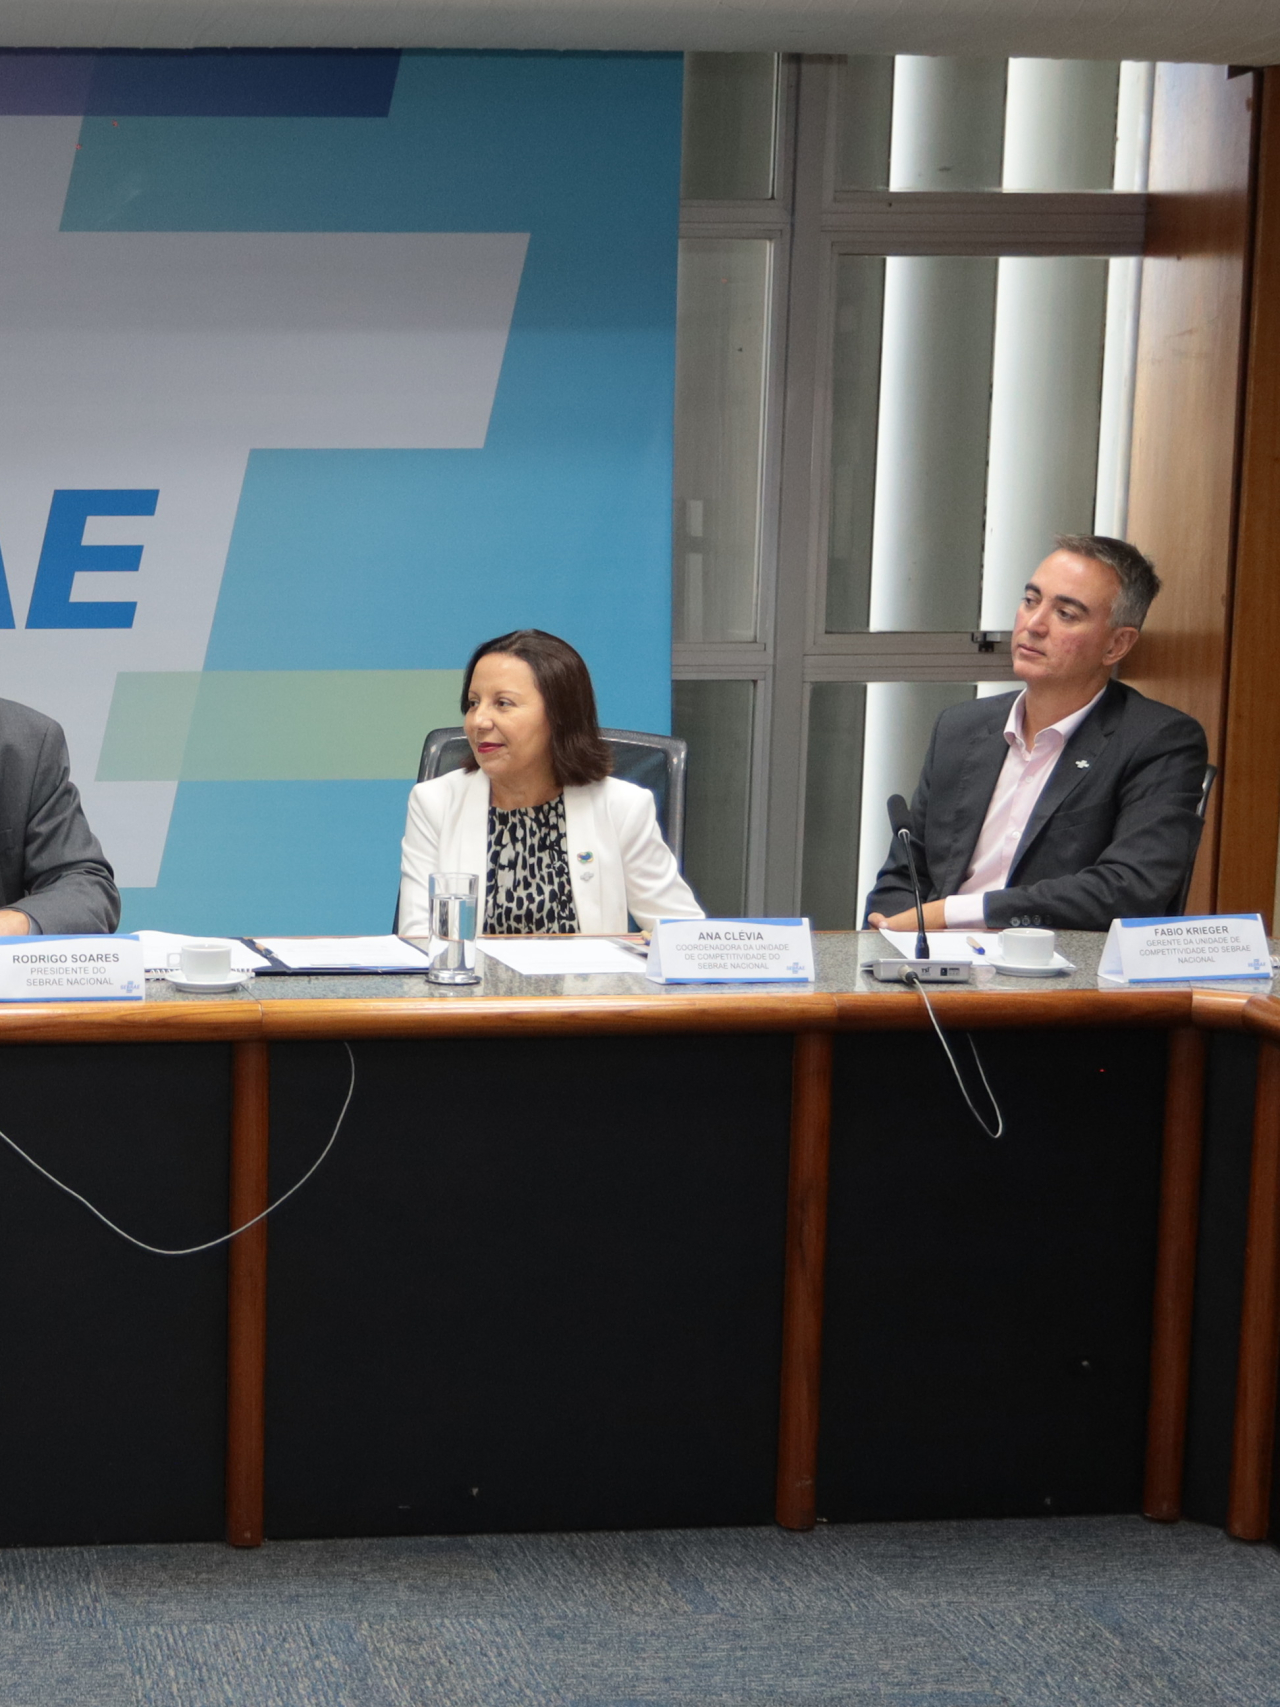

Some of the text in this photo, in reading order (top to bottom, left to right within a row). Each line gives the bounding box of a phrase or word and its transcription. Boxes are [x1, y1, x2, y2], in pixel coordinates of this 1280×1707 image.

[698, 929, 763, 941] ANA CLÉVIA
[1154, 926, 1229, 936] FABIO KRIEGER
[1146, 939, 1181, 947] GERENTE
[1139, 947, 1206, 956] COMPETITIVIDADE
[12, 953, 119, 964] RODRIGO SOARES
[1178, 956, 1215, 964] NACIONAL
[31, 967, 89, 975] PRESIDENTE
[66, 978, 113, 986] NACIONAL
